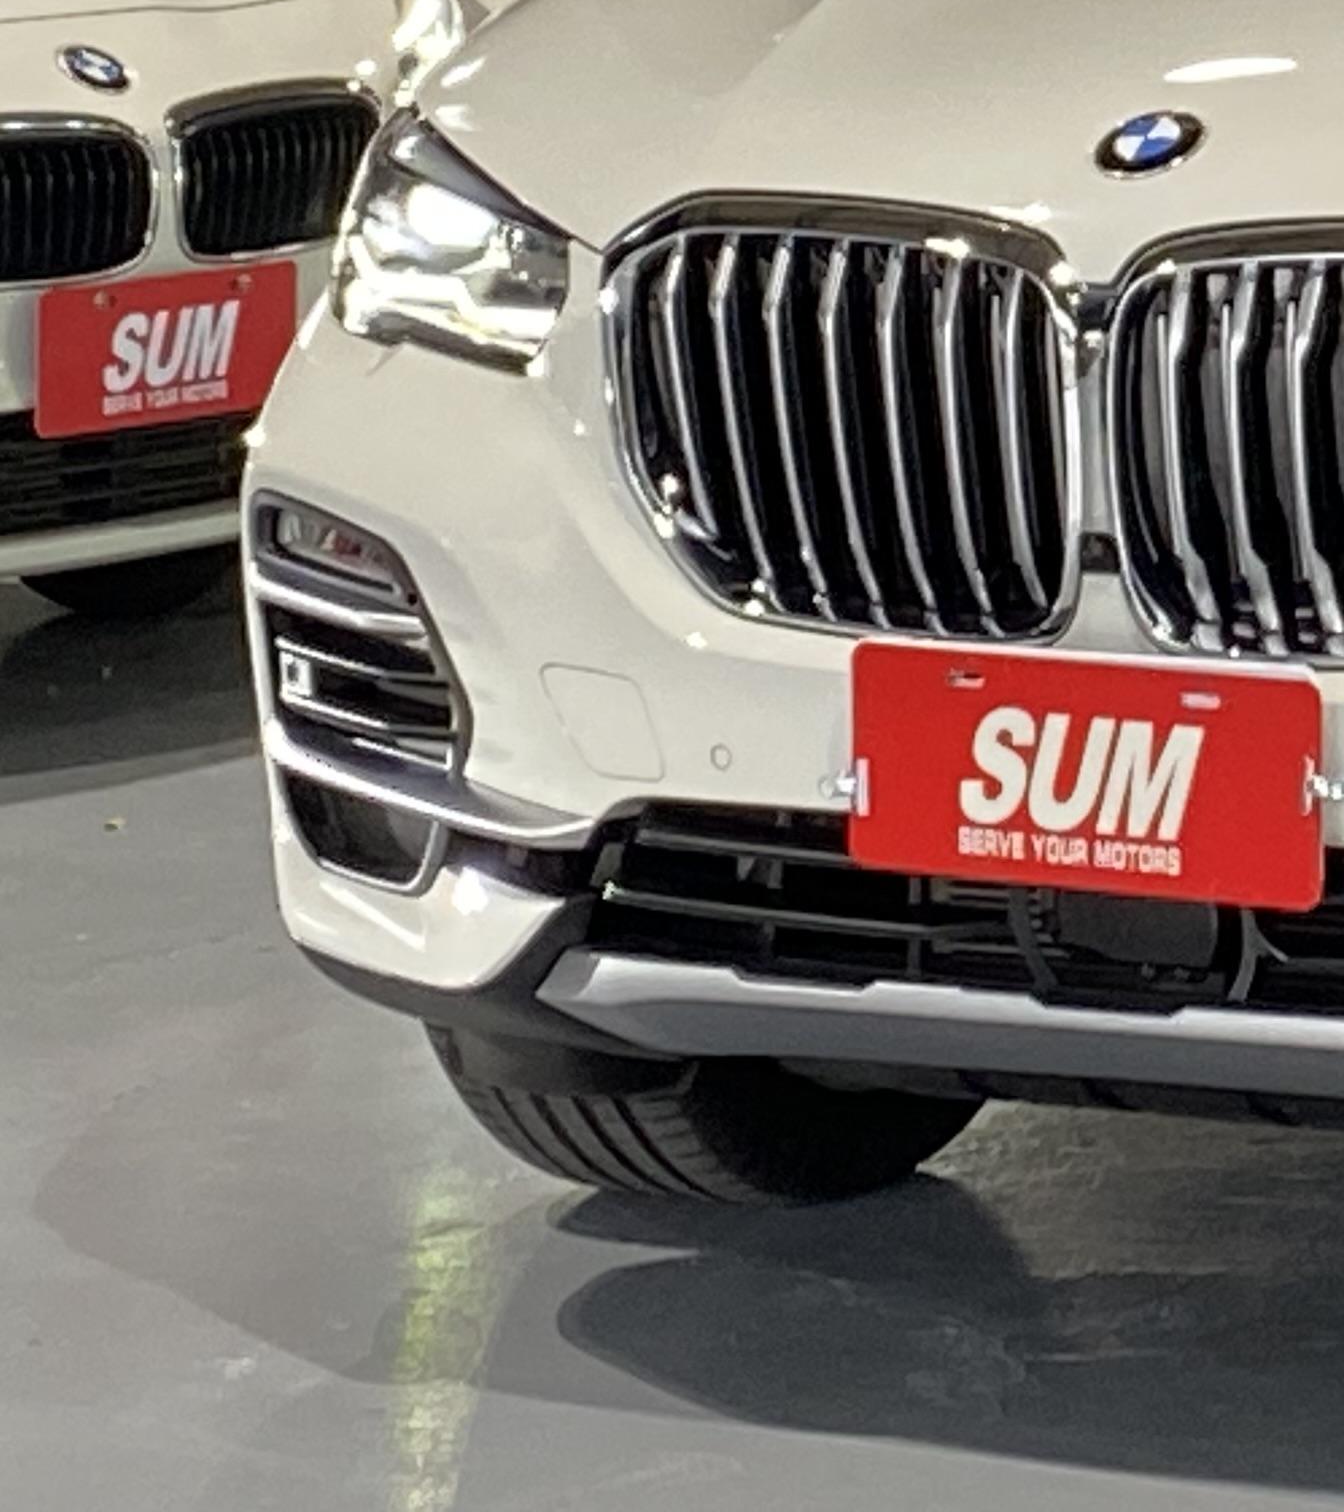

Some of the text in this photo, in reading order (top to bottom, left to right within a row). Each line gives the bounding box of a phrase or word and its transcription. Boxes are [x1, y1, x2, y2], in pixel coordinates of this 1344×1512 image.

[103, 299, 240, 393] SUM
[959, 706, 1205, 841] SUM
[958, 825, 1182, 876] SERVE YOUR MOTORS
